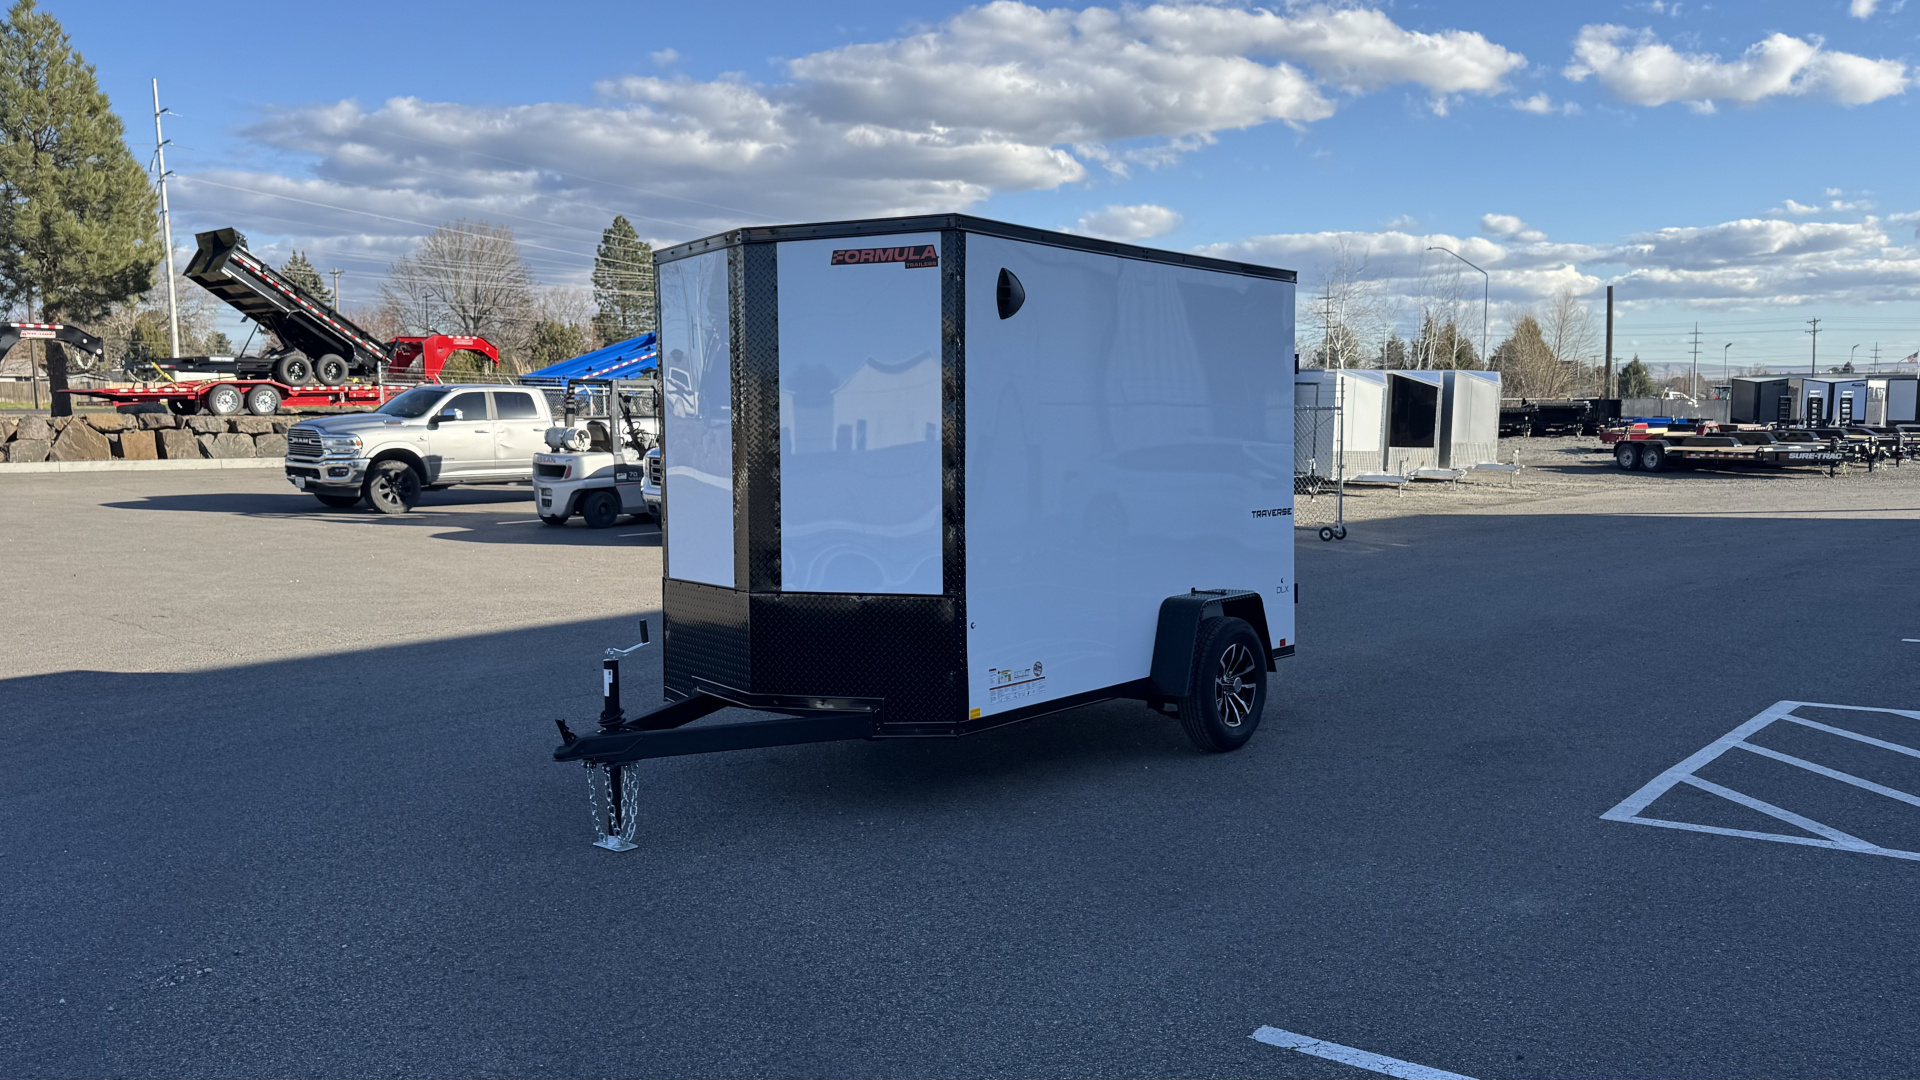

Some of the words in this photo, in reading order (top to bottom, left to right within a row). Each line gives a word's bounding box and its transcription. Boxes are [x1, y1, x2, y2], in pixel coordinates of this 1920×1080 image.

[831, 245, 937, 264] FORMULA
[1788, 452, 1843, 460] SURE-TRAC
[1251, 507, 1293, 518] TRAVERSE
[1276, 585, 1289, 594] DLX
